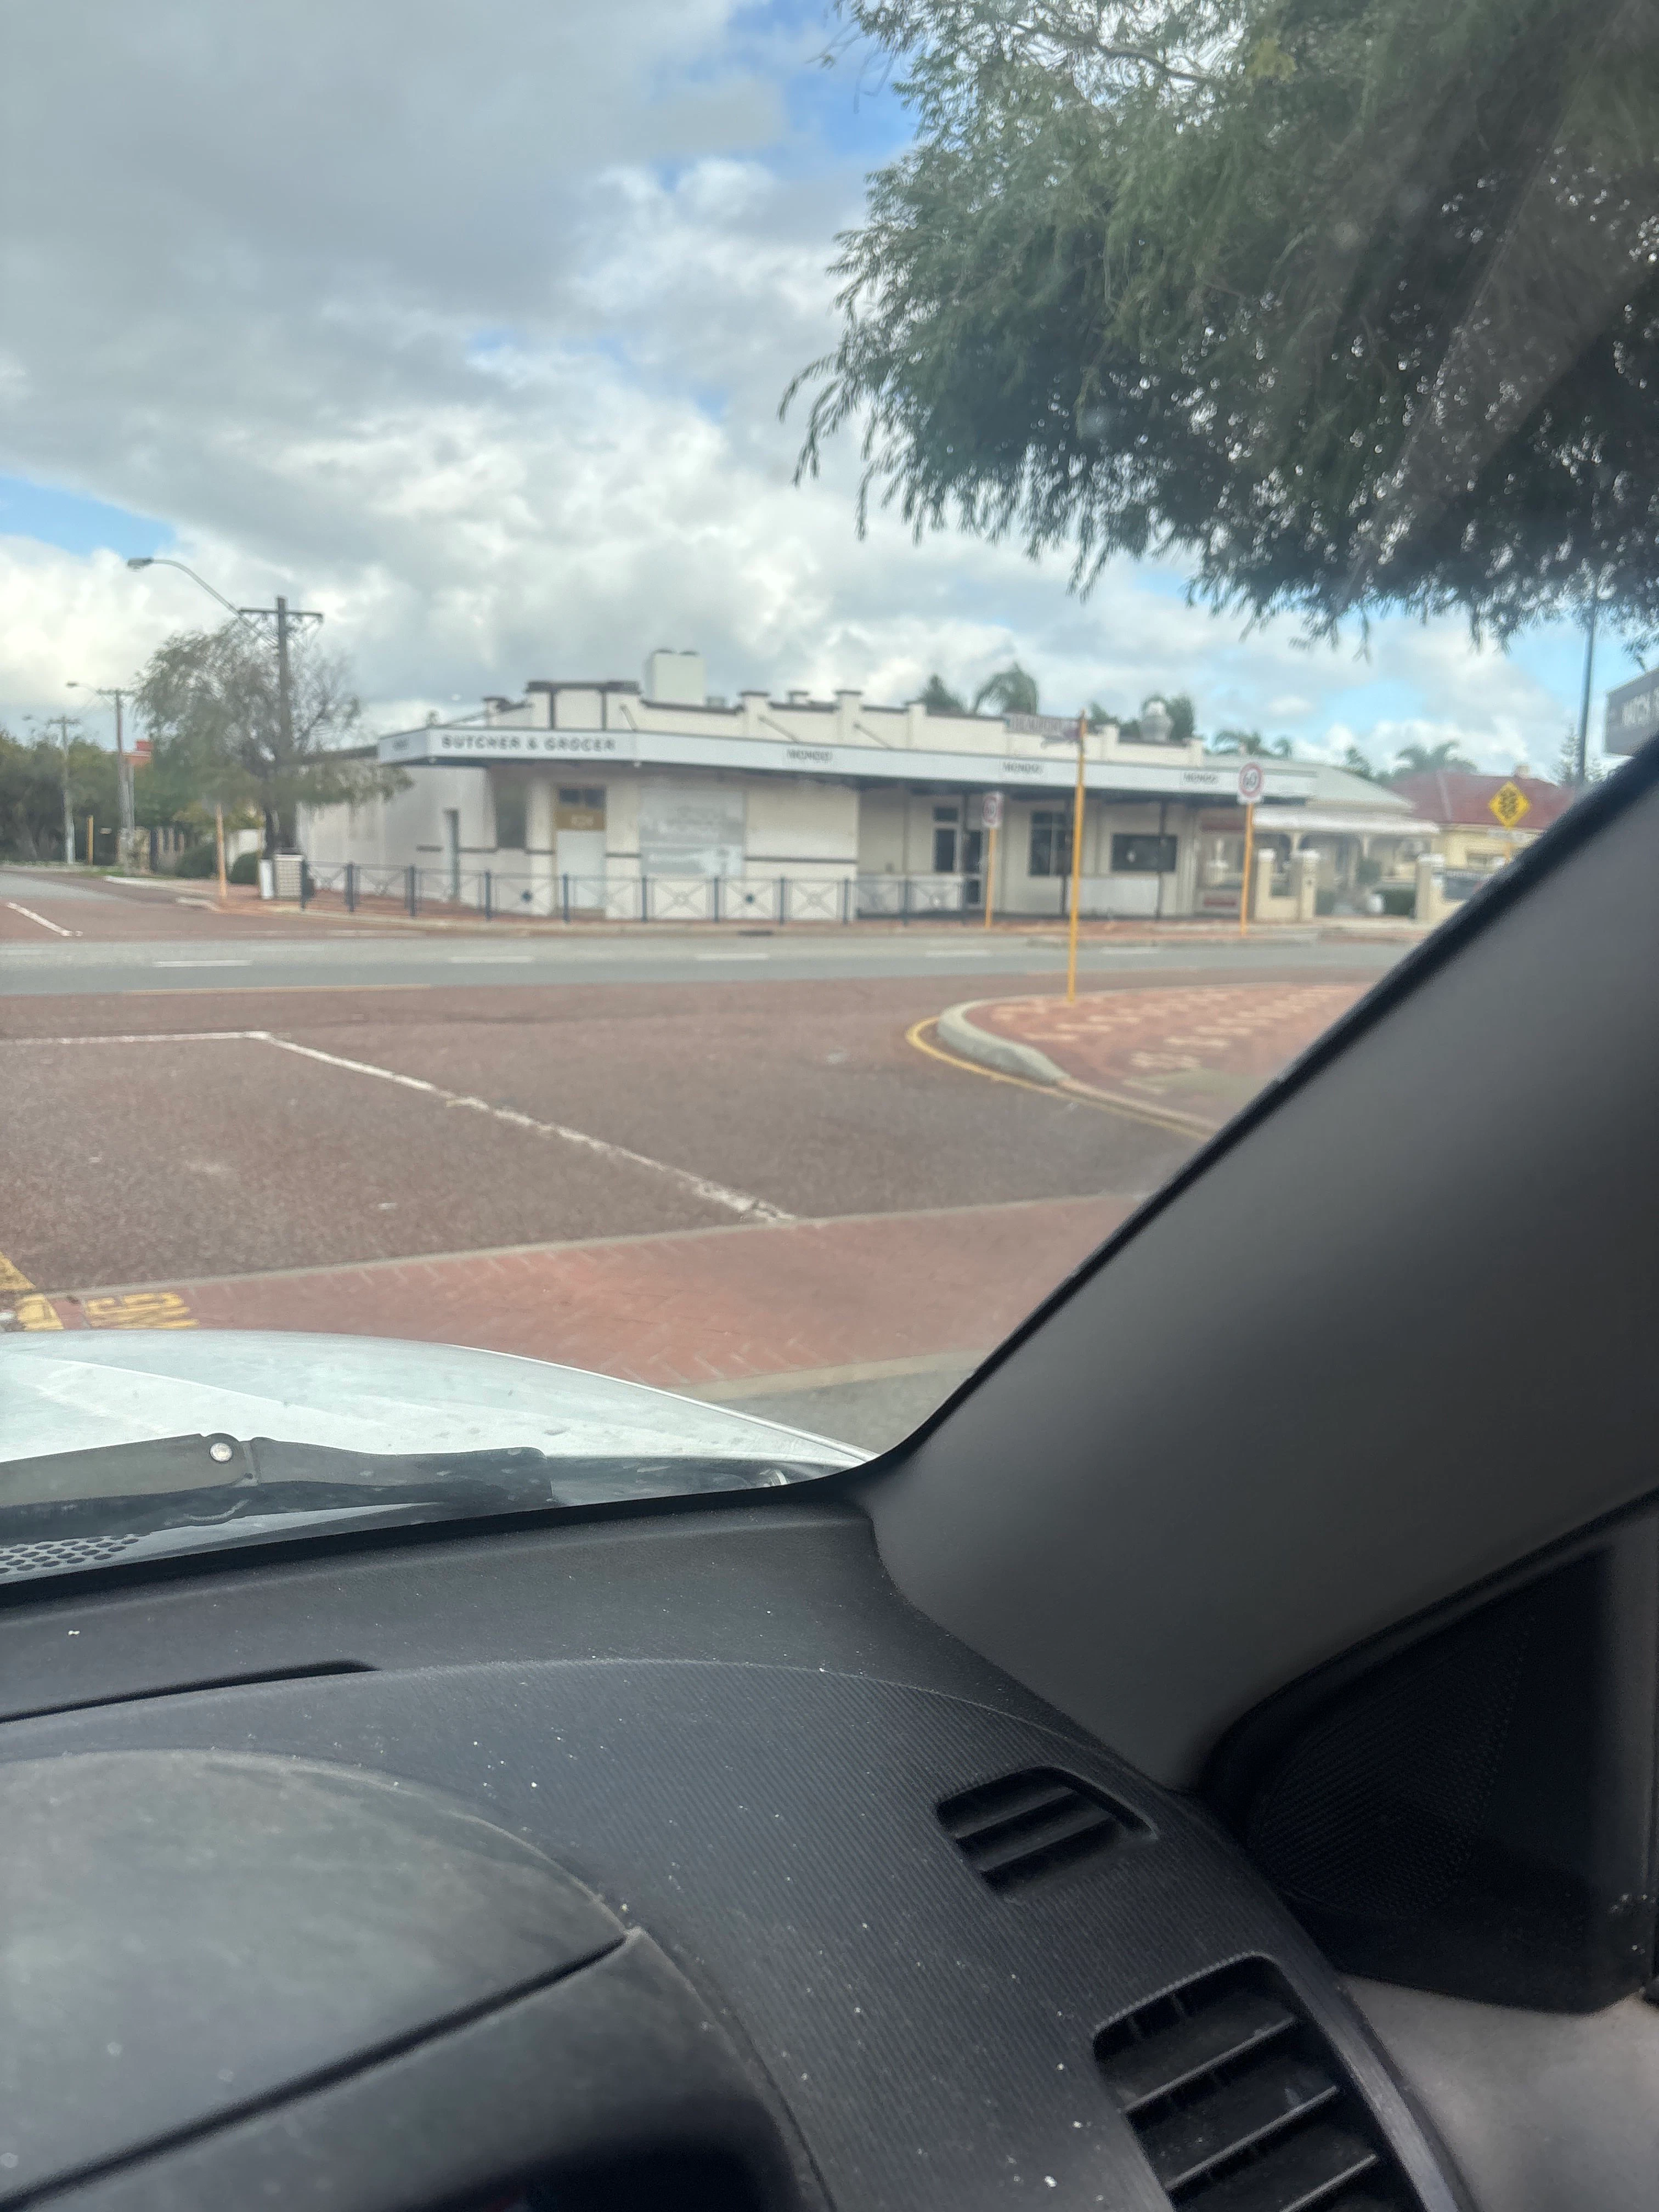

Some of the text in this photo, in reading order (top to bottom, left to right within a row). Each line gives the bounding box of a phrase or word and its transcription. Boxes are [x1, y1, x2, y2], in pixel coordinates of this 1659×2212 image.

[441, 733, 616, 752] BUTCHER & GROCER
